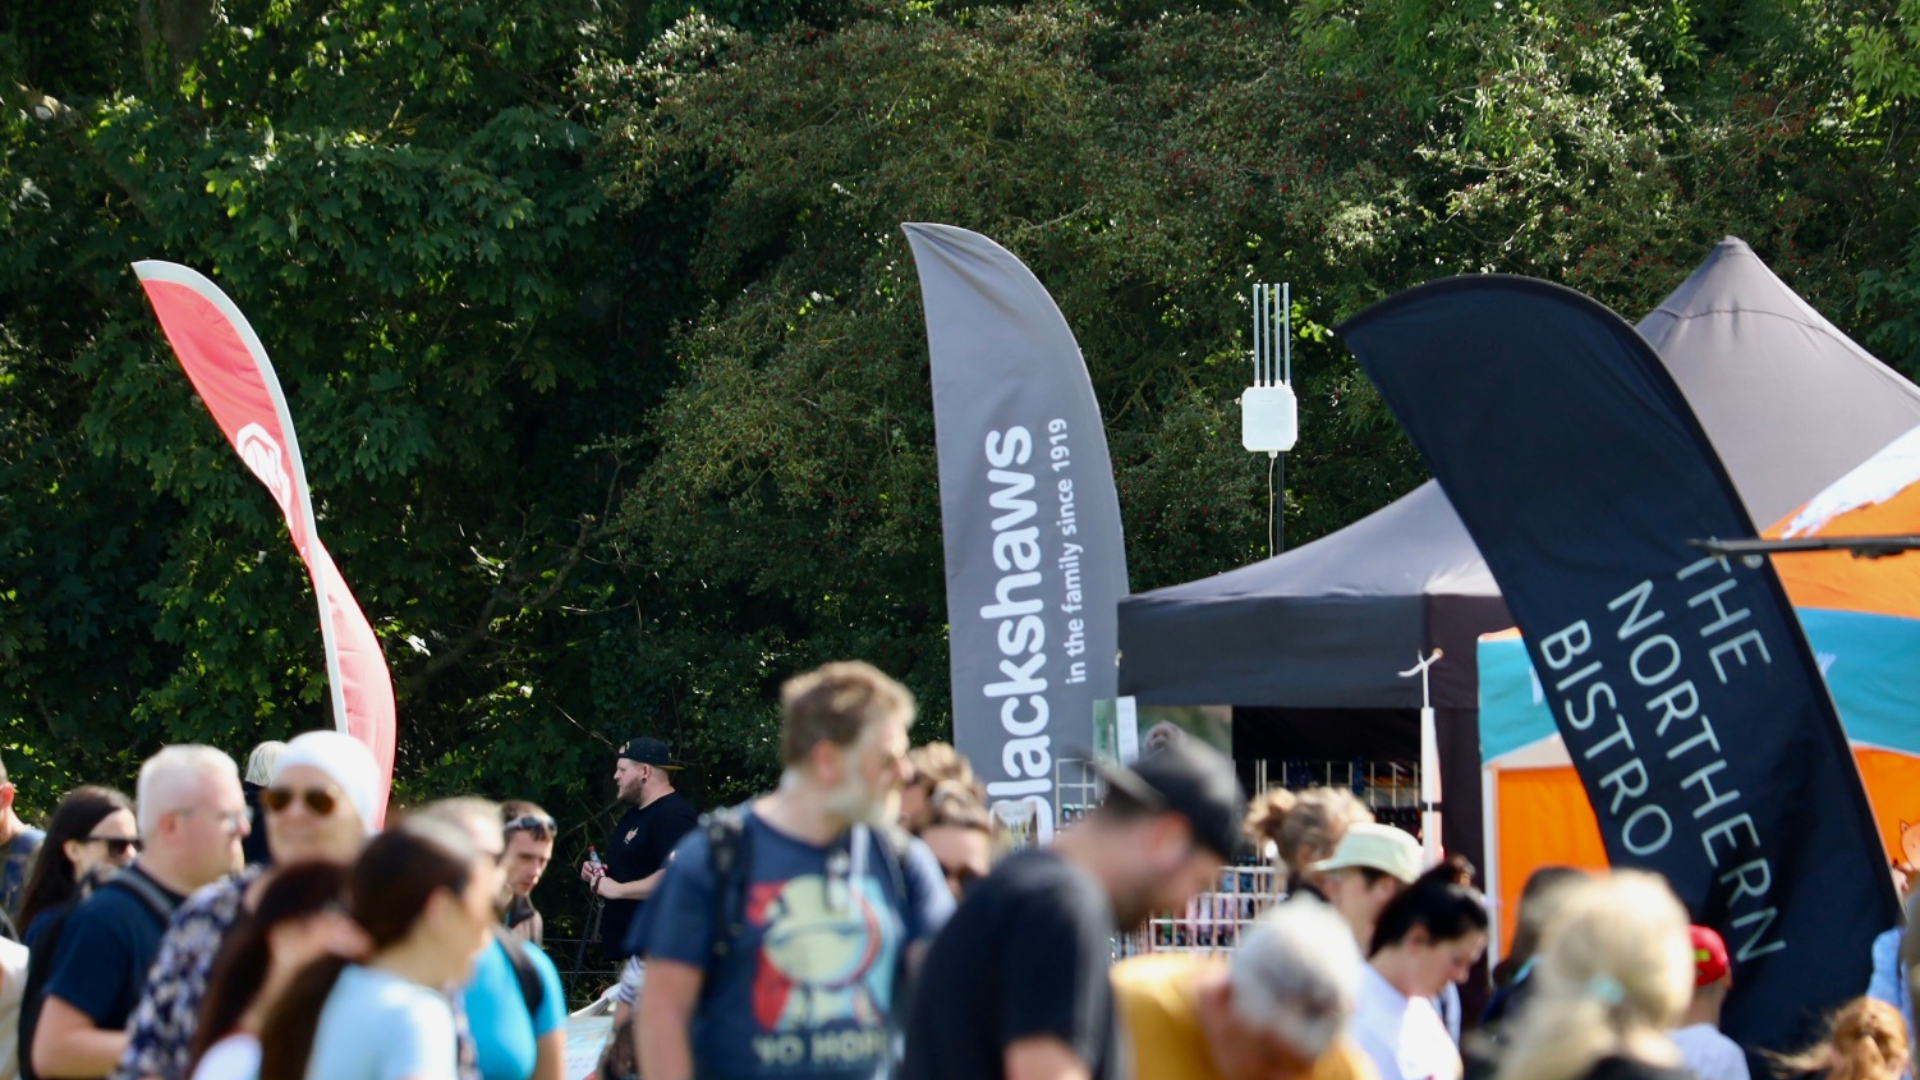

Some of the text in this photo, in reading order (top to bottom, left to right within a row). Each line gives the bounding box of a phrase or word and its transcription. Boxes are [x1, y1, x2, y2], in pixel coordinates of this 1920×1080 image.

[1048, 418, 1086, 684] in the family since 1919
[1540, 619, 1673, 855] BISTRO
[1607, 579, 1786, 962] NORTHERN
